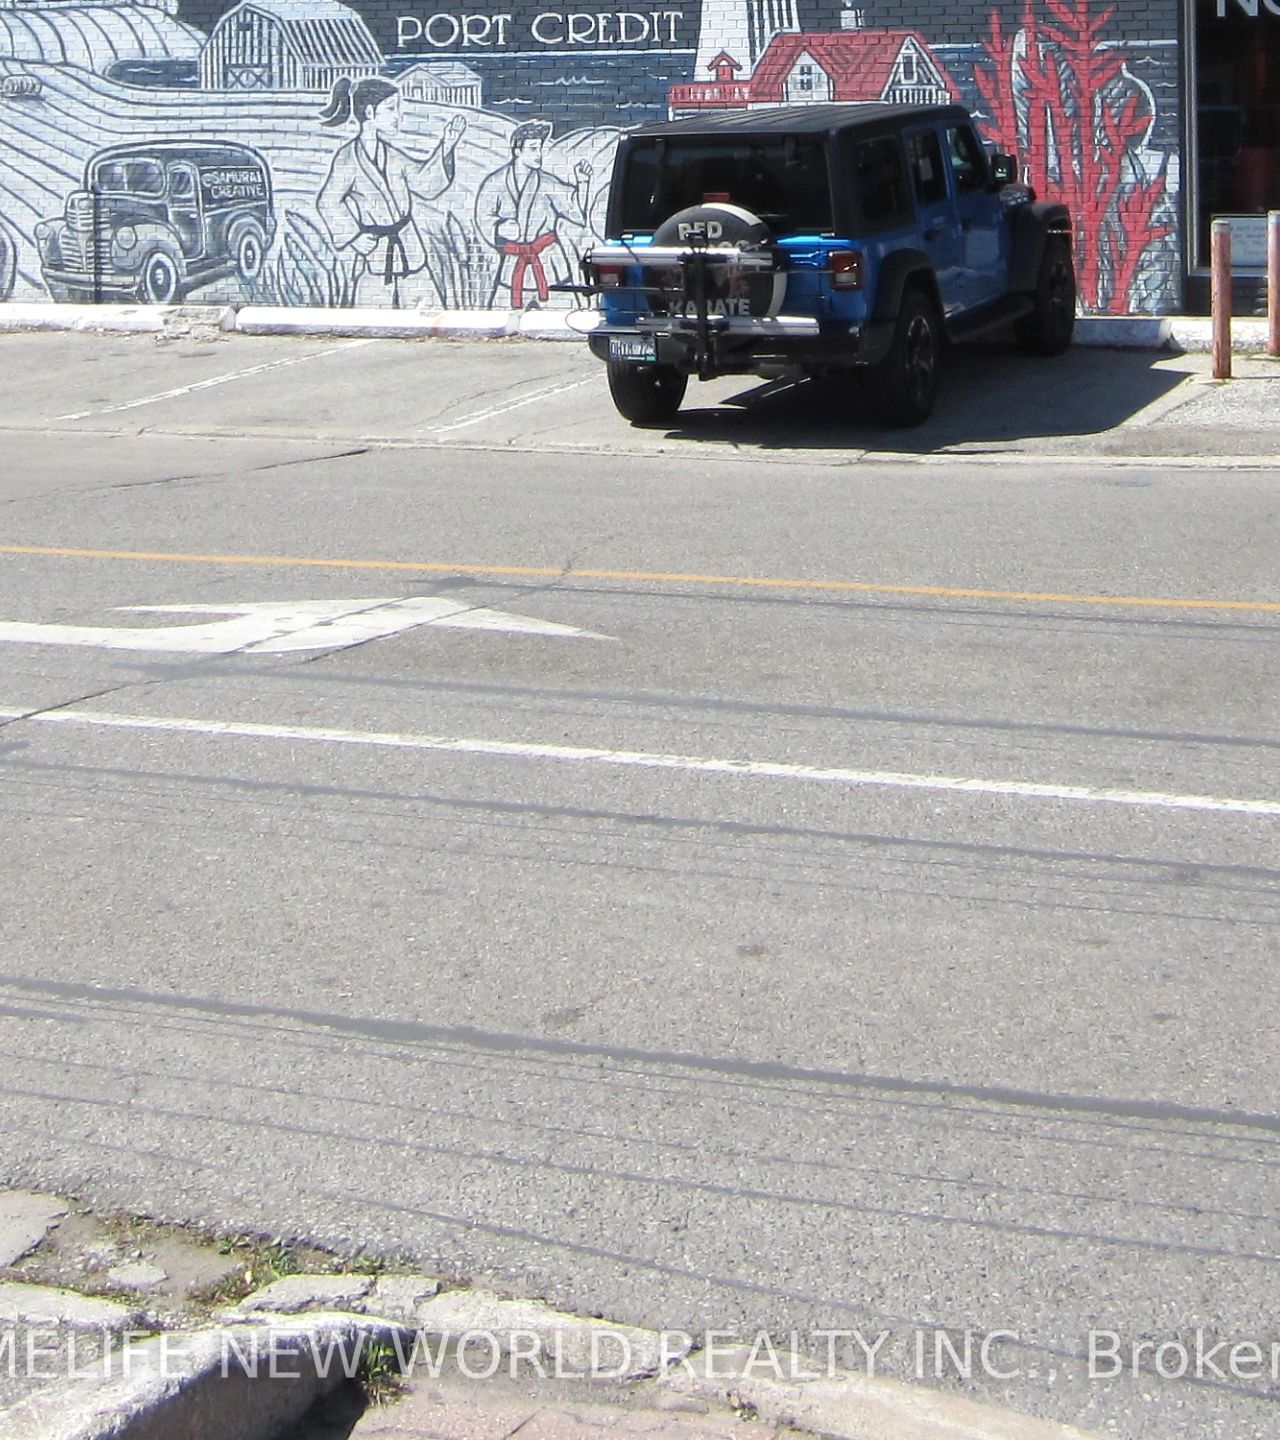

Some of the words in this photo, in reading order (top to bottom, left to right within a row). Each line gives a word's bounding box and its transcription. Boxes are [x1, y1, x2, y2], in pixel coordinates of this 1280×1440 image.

[396, 14, 512, 47] PORT
[531, 12, 683, 45] CREDIT
[211, 184, 265, 199] CREATIVE
